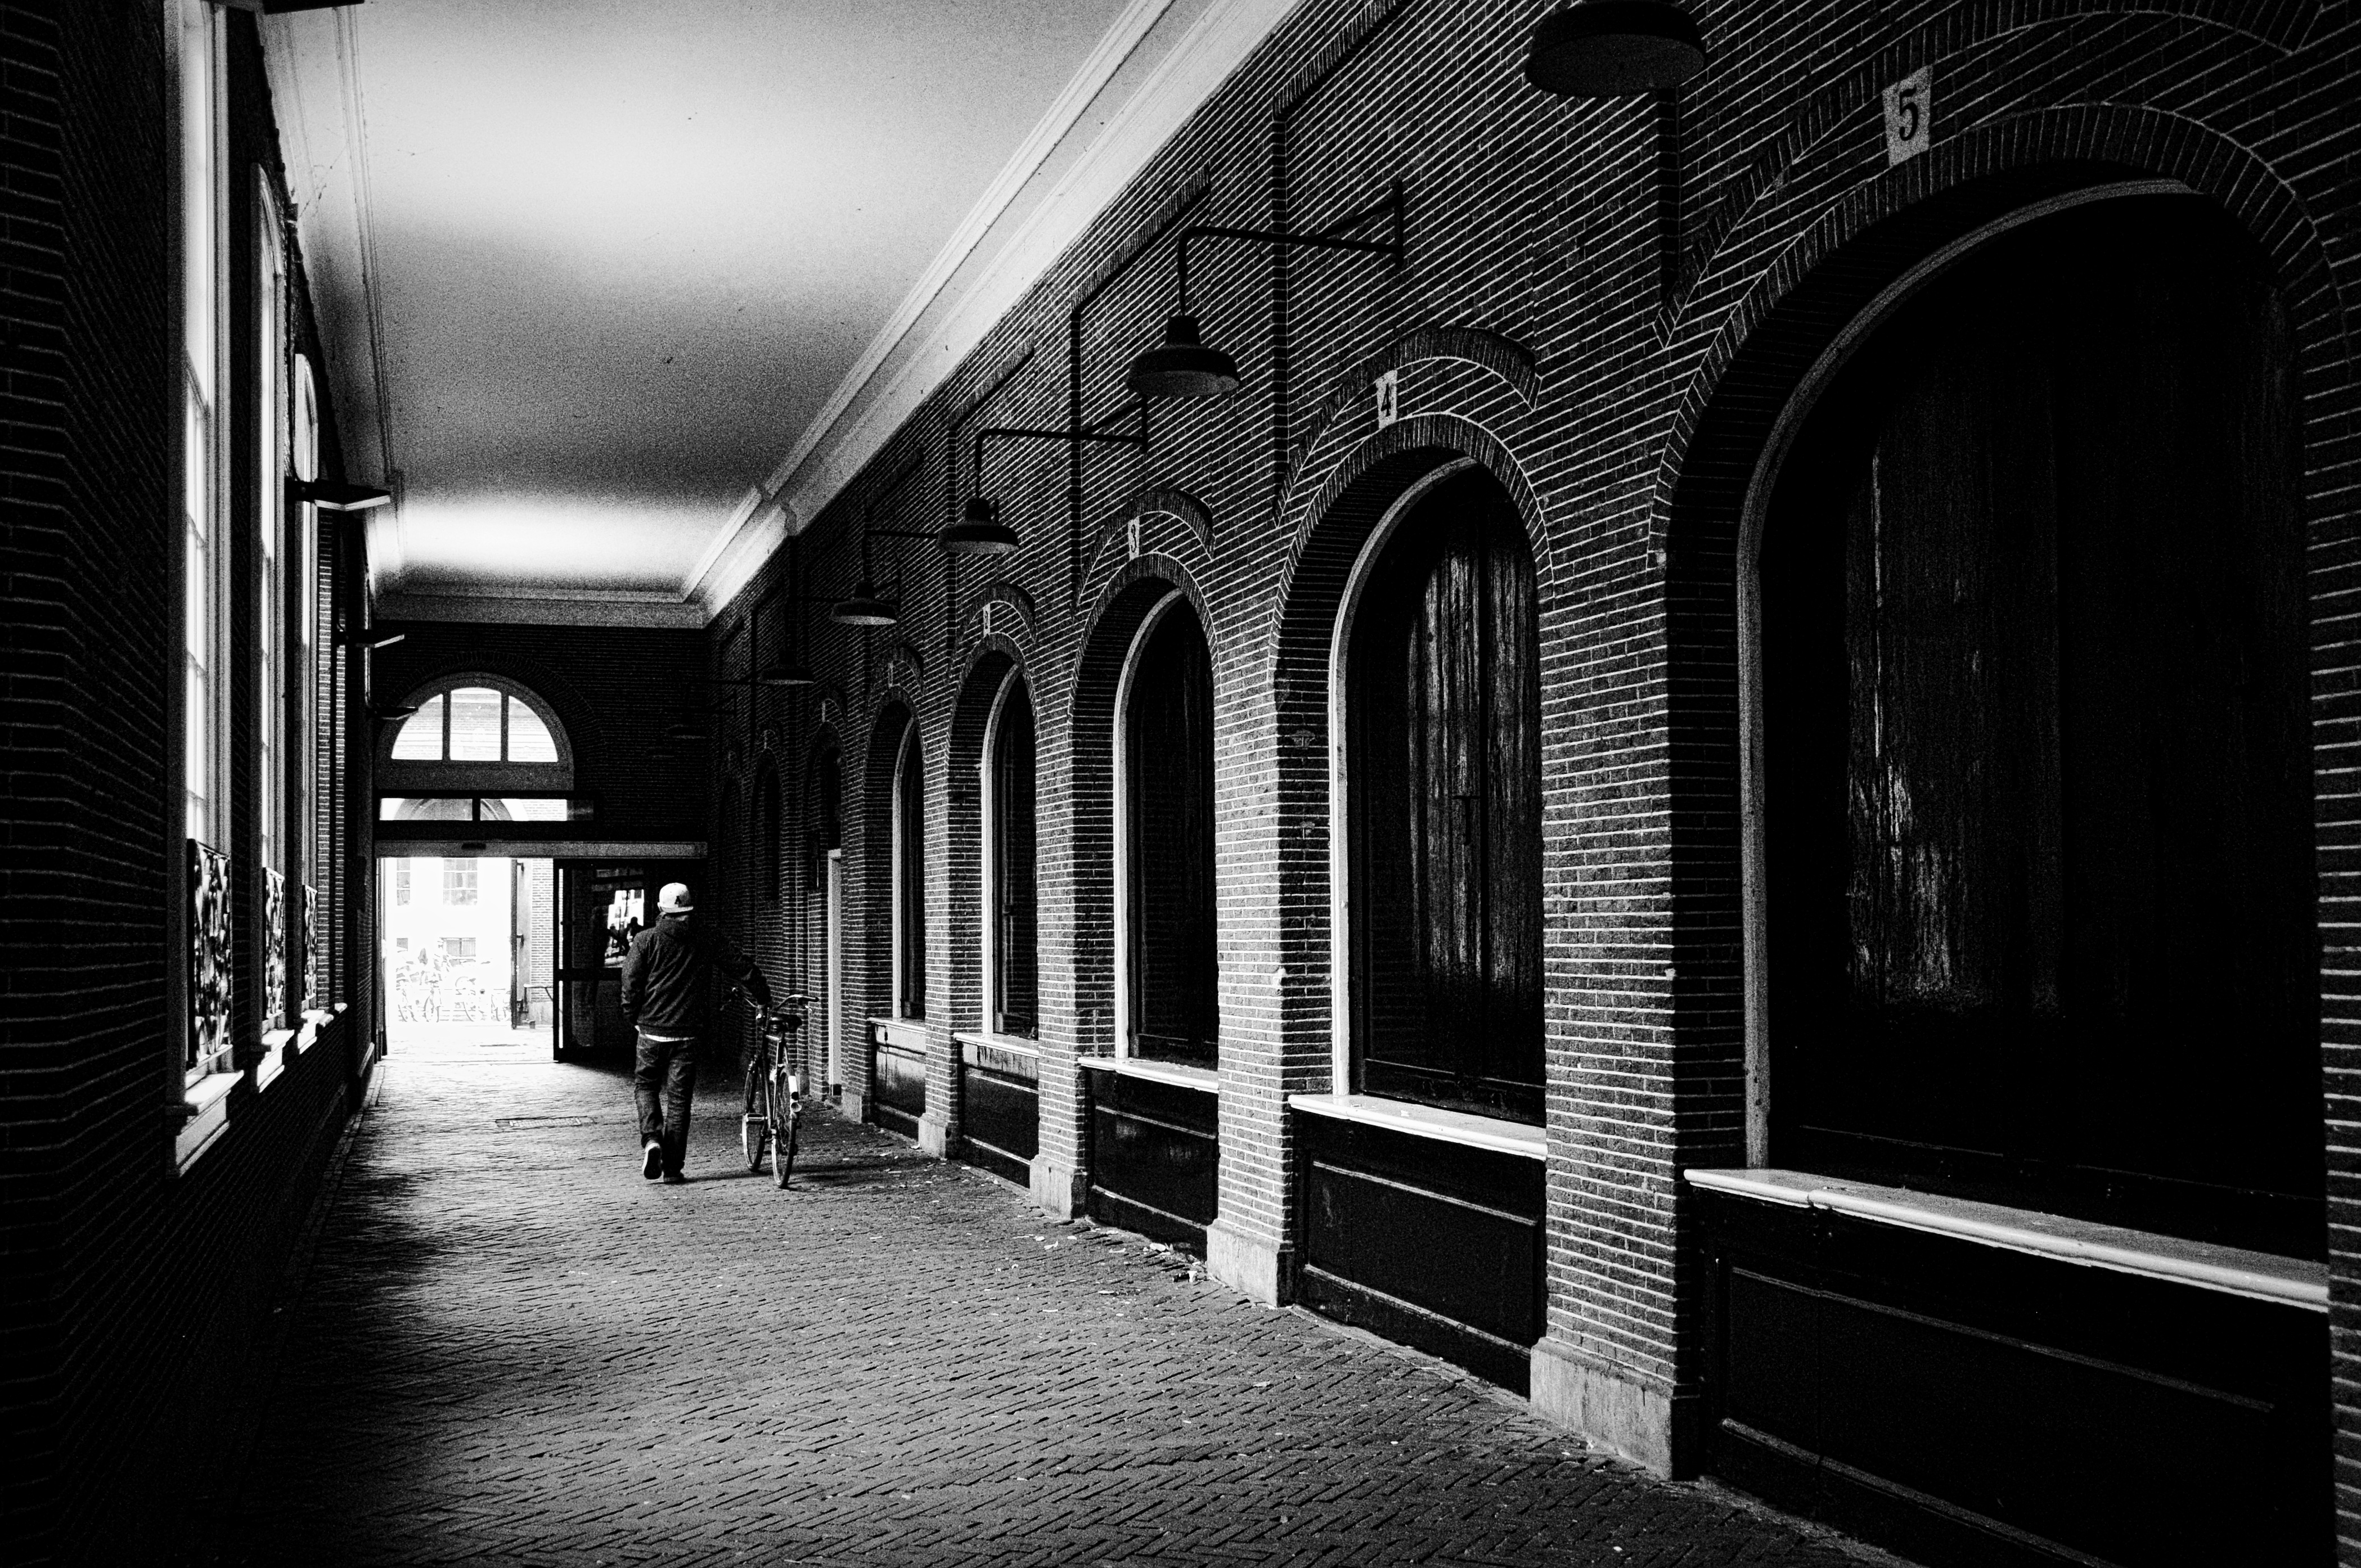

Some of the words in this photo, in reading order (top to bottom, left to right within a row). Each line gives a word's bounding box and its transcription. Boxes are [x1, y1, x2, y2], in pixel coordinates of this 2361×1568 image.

[1899, 85, 1919, 141] 5
[1381, 382, 1391, 417] 4
[1131, 524, 1136, 553] 3
